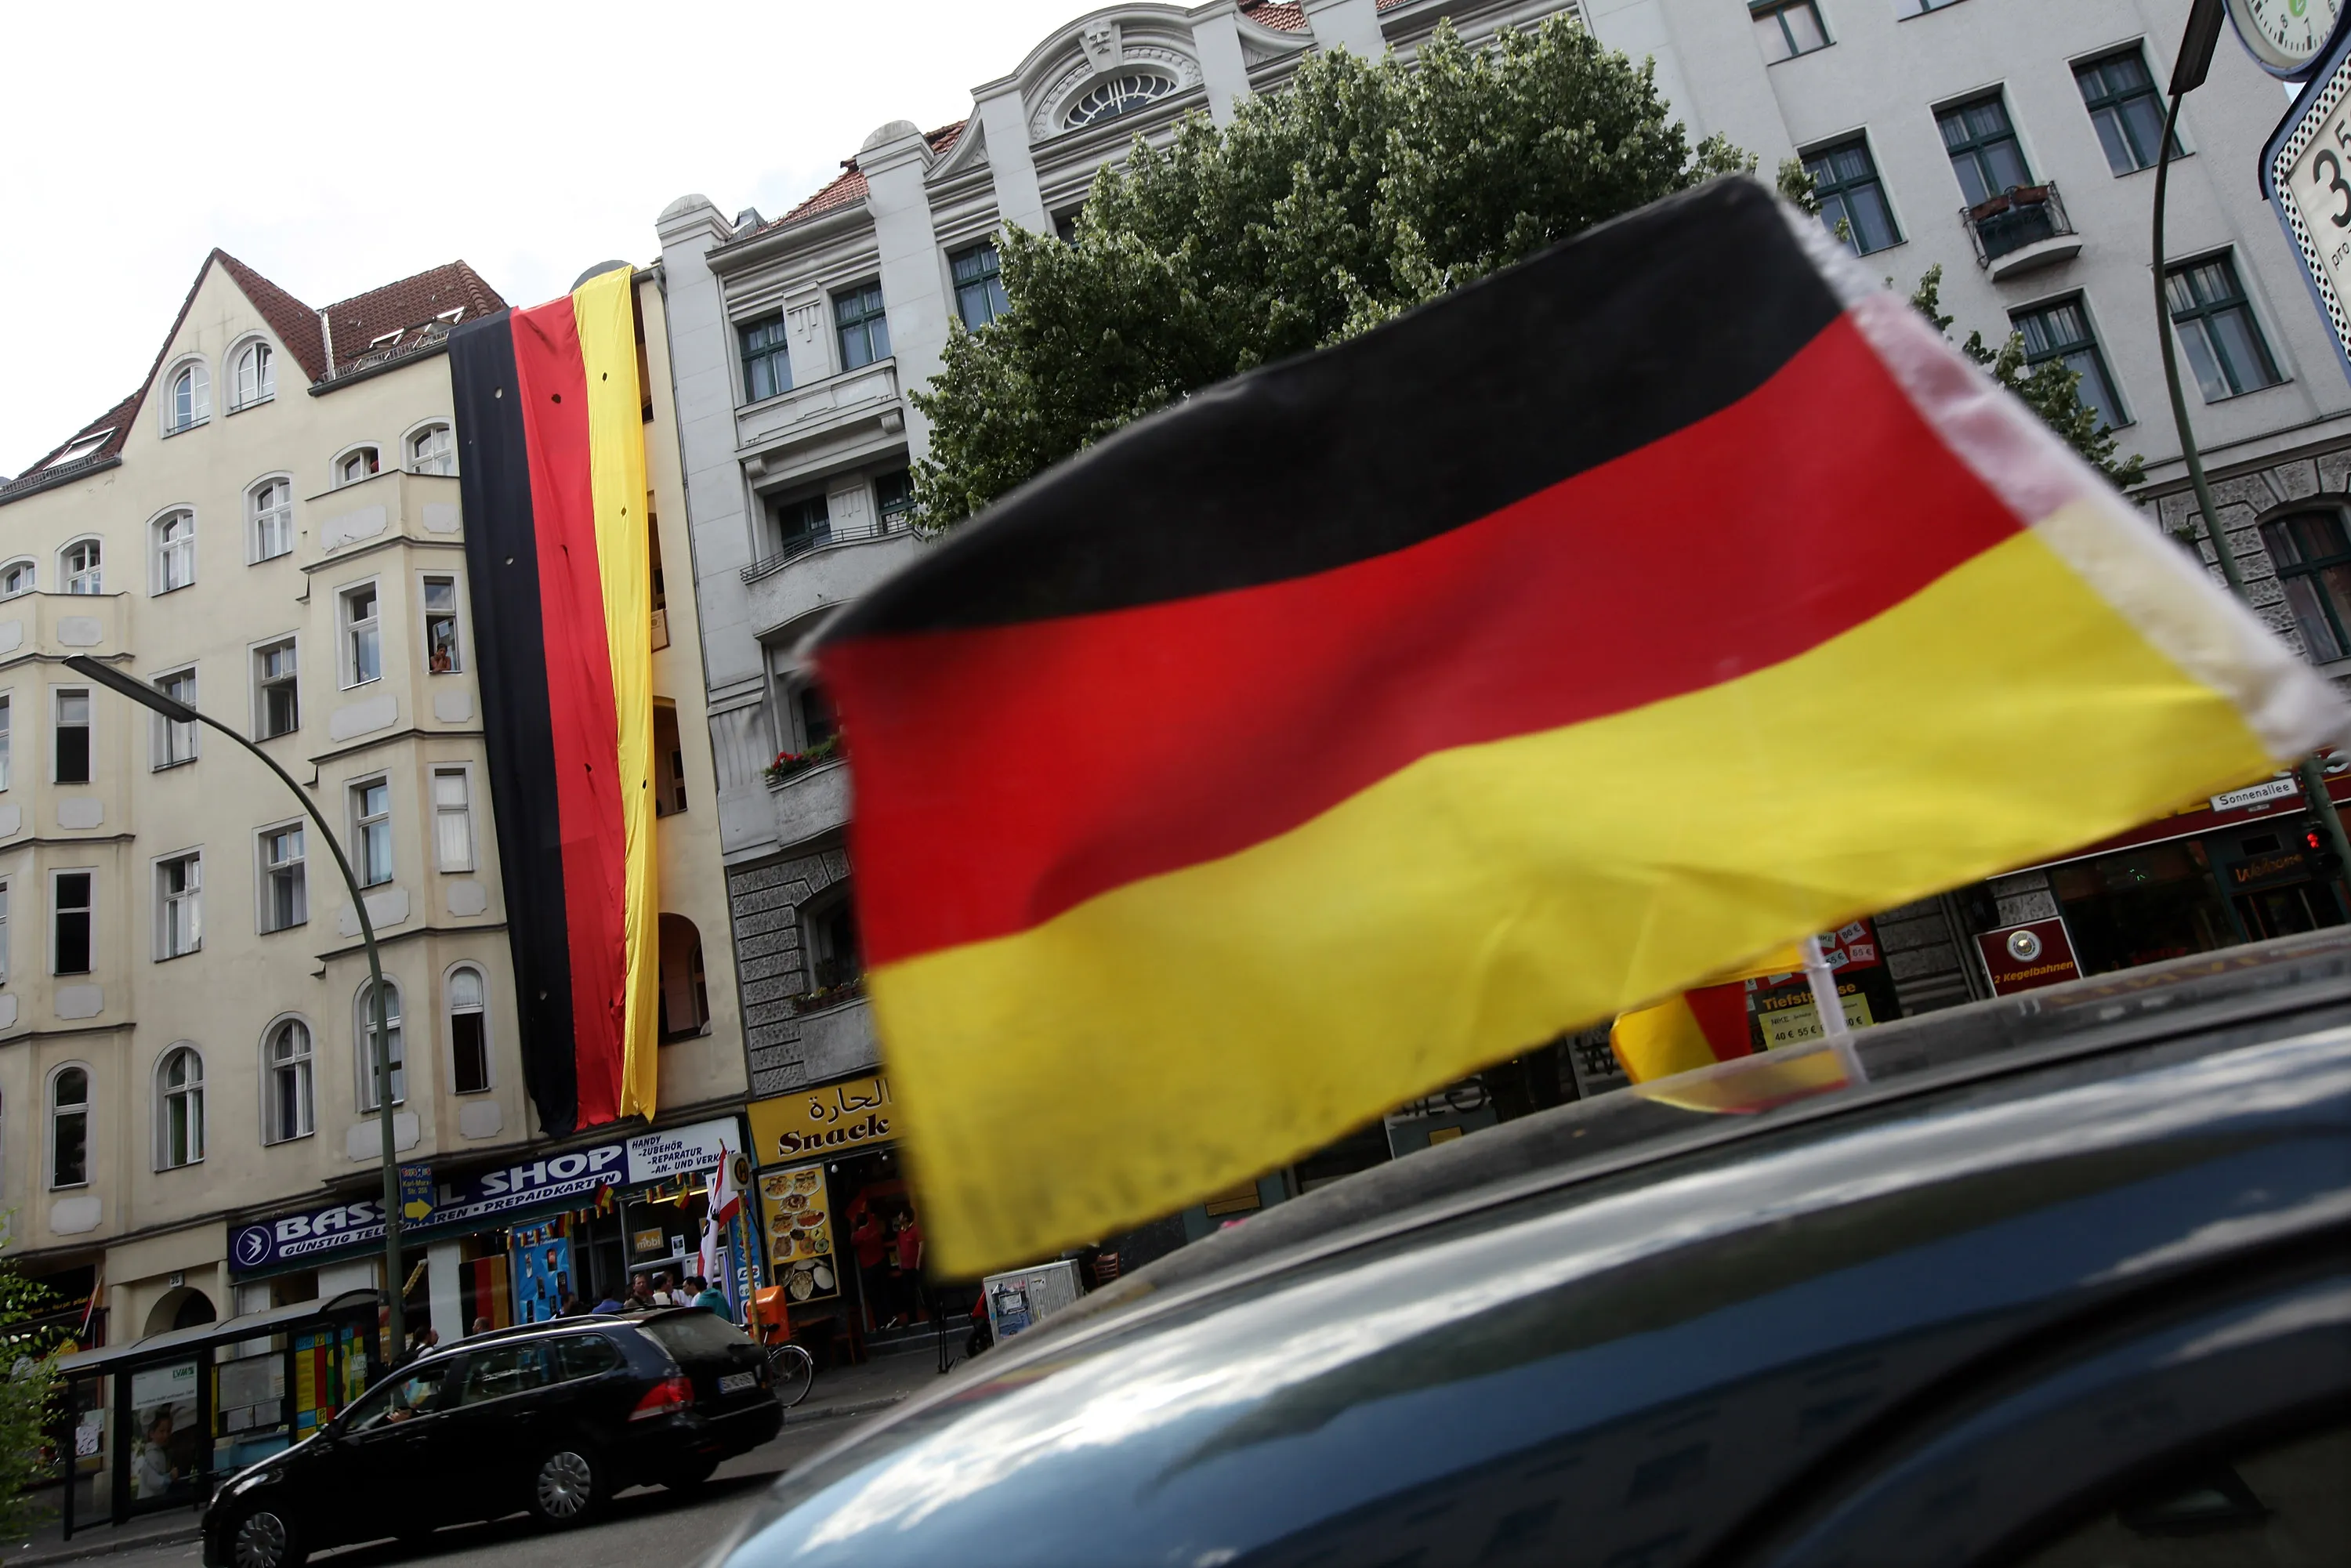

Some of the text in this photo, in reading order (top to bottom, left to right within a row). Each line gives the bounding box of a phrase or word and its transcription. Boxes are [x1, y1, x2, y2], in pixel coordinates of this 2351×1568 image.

[2280, 13, 2288, 29] 8
[2304, 16, 2312, 34] 7
[2331, 242, 2349, 271] pro
[2219, 783, 2290, 806] Sonnenallee
[1994, 961, 2074, 984] 2 Kegelbahnen
[1762, 983, 1857, 1010] Tiefstpse
[1775, 1031, 1786, 1041] 40
[1798, 1027, 1809, 1037] 55
[1810, 1025, 1817, 1034] €
[1856, 1016, 1863, 1025] €
[632, 1135, 661, 1150] HANDY
[779, 1113, 891, 1157] Snack
[638, 1141, 683, 1157] -ZUBEHÖR
[647, 1147, 702, 1164] -REPARATUR
[480, 1145, 623, 1197] SHOP
[651, 1164, 672, 1175] -AN-
[675, 1159, 694, 1170] UND
[284, 1234, 350, 1255] GÜNSTIG
